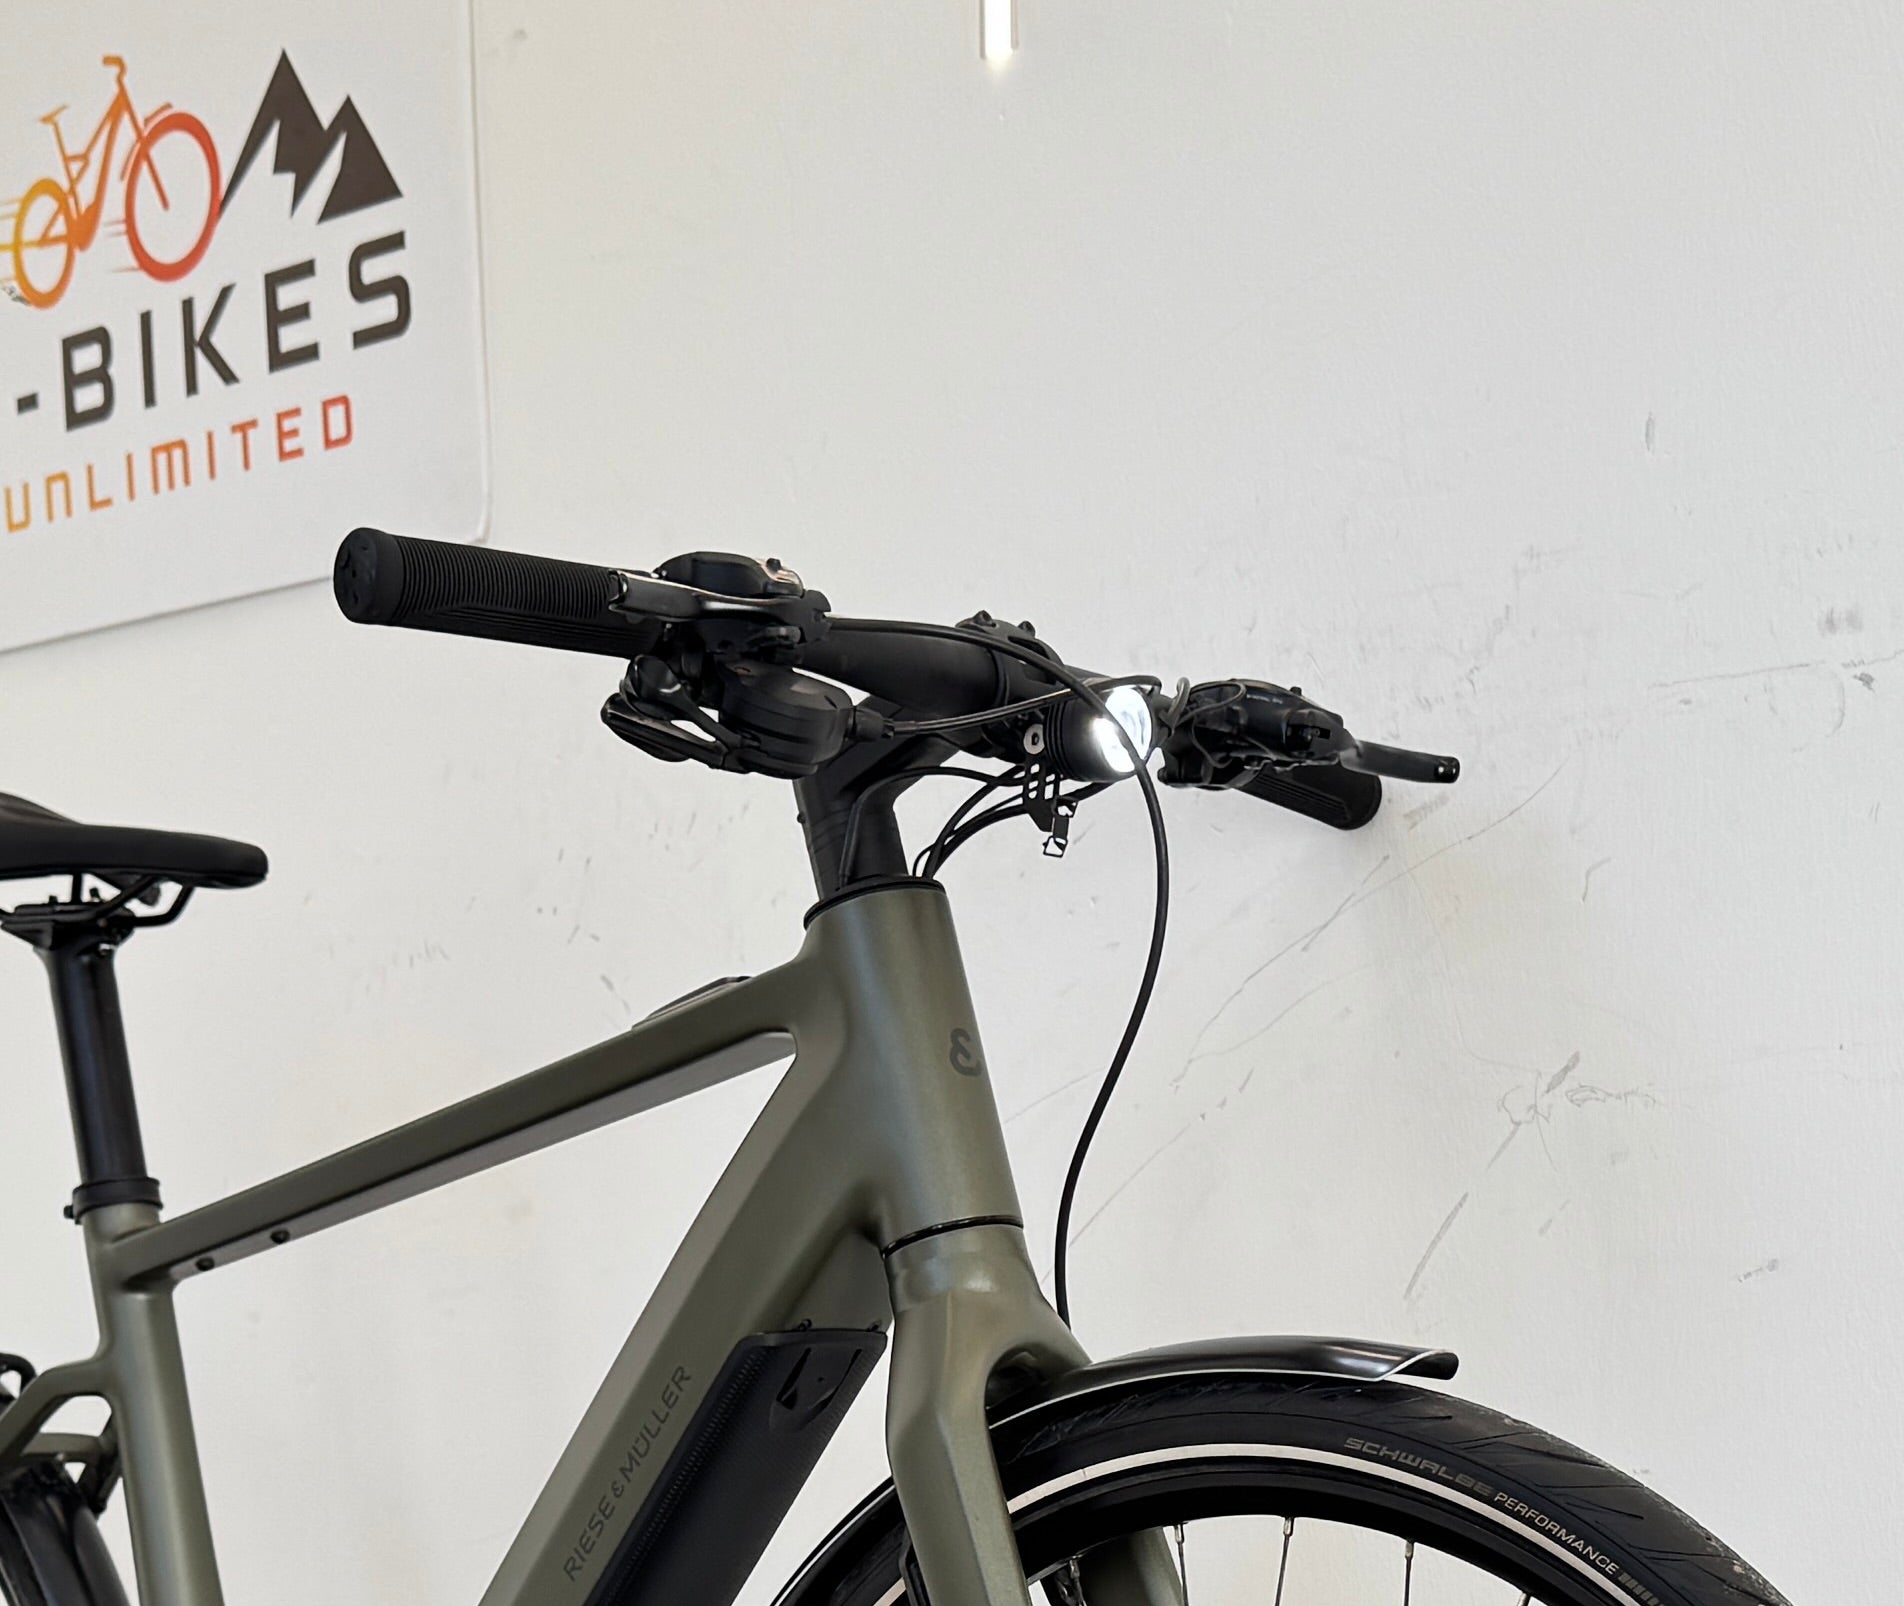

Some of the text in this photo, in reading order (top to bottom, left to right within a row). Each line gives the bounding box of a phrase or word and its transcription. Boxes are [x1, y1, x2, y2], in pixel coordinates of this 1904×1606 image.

[3, 394, 354, 533] UNLIMITED
[562, 1495, 616, 1582] RIESE
[618, 1365, 692, 1484] MÜLLER
[1343, 1436, 1621, 1575] SCHWALBE PERFORMANCE
